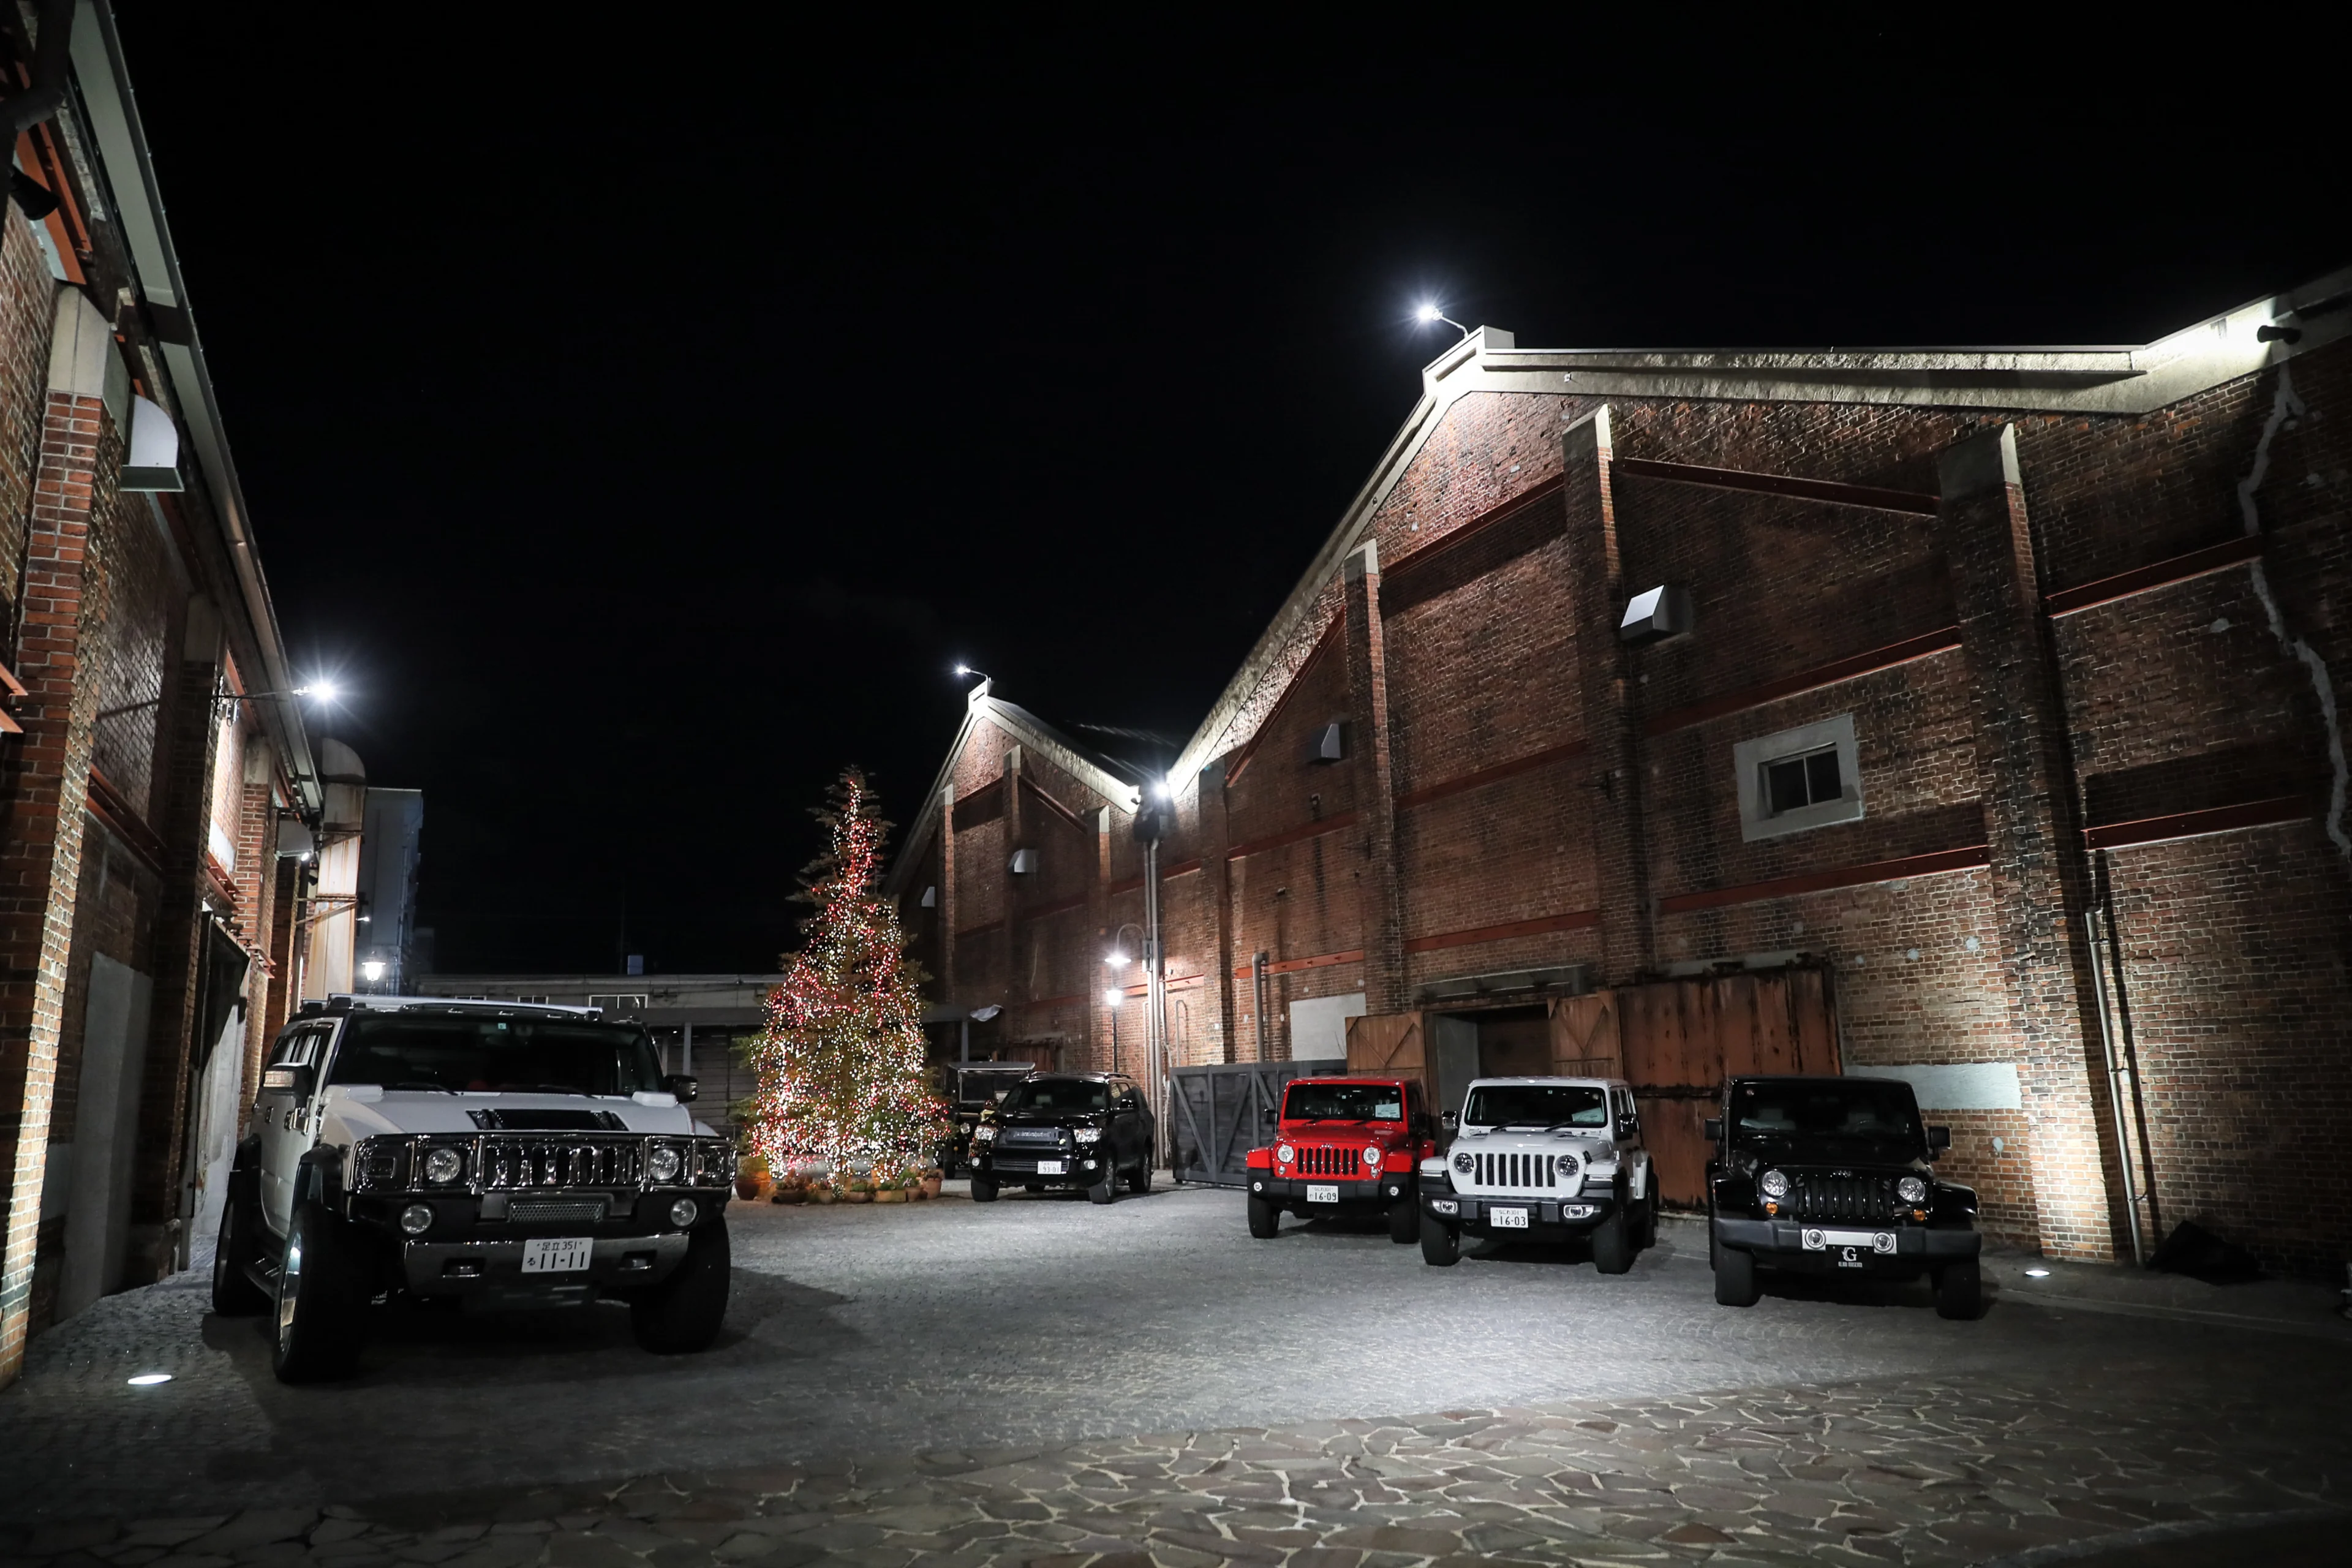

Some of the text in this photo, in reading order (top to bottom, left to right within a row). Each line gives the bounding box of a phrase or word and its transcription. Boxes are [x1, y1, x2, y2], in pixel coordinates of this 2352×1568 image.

[1315, 1192, 1336, 1201] 16-09
[1500, 1215, 1526, 1226] 16-03
[540, 1251, 584, 1269] 11-11
[1841, 1246, 1857, 1262] G
